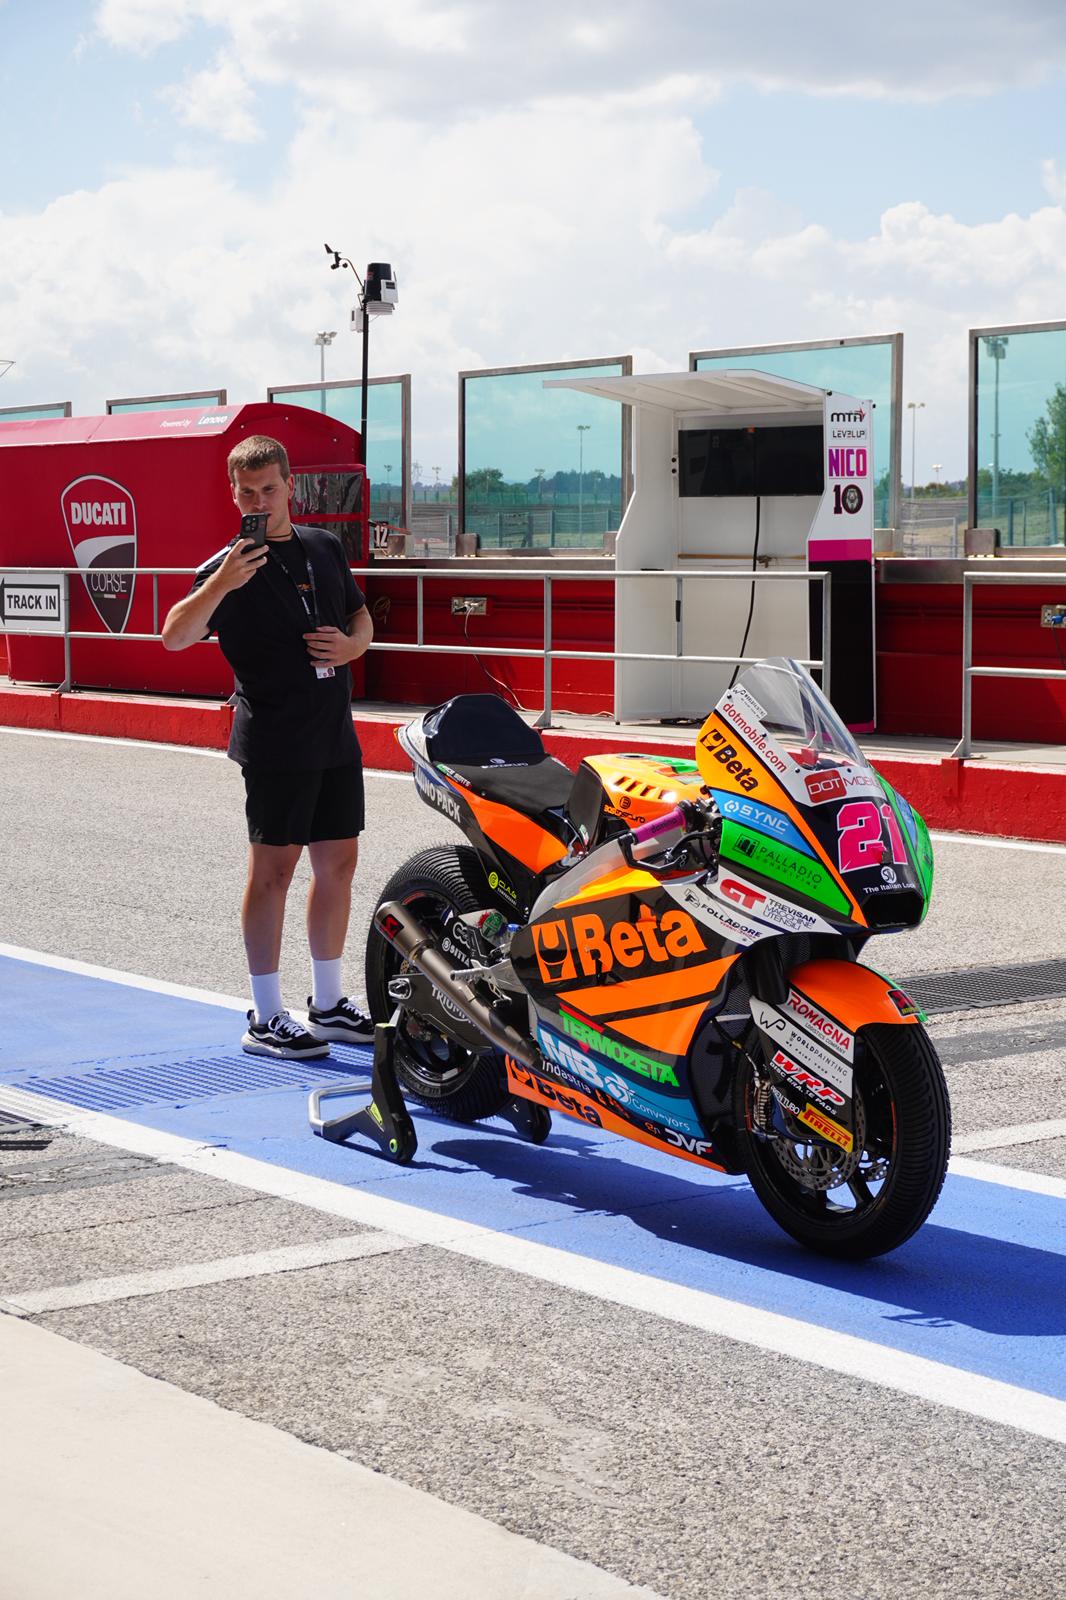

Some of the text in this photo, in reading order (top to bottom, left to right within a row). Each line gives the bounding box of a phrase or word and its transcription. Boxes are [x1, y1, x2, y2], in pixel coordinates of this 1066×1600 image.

[198, 415, 227, 425] Lenovo
[828, 448, 867, 477] NICO
[70, 502, 127, 525] DUCATI
[833, 484, 864, 514] 10
[374, 526, 388, 547] 12
[91, 573, 127, 593] CORSE
[7, 595, 56, 610] TRACK IN
[722, 702, 788, 774] dotmobile.com
[713, 743, 759, 792] Beta
[808, 777, 841, 795] DOT
[437, 788, 461, 823] PACK
[740, 804, 788, 832] SYNC
[837, 801, 908, 874] 21
[760, 846, 822, 883] PALLADIO
[720, 878, 767, 910] GT
[862, 886, 879, 895] The
[701, 903, 763, 937] FOLLADORE
[769, 898, 817, 924] TREVISAN
[572, 903, 709, 977] Beta
[788, 991, 852, 1050] ROMAGNA
[540, 1028, 604, 1088] MB
[559, 1009, 680, 1087] TERMOZETA
[769, 1062, 786, 1078] DISC
[815, 1098, 837, 1115] PADS
[772, 1051, 845, 1105] WRP
[803, 1109, 852, 1147] PIRELLI
